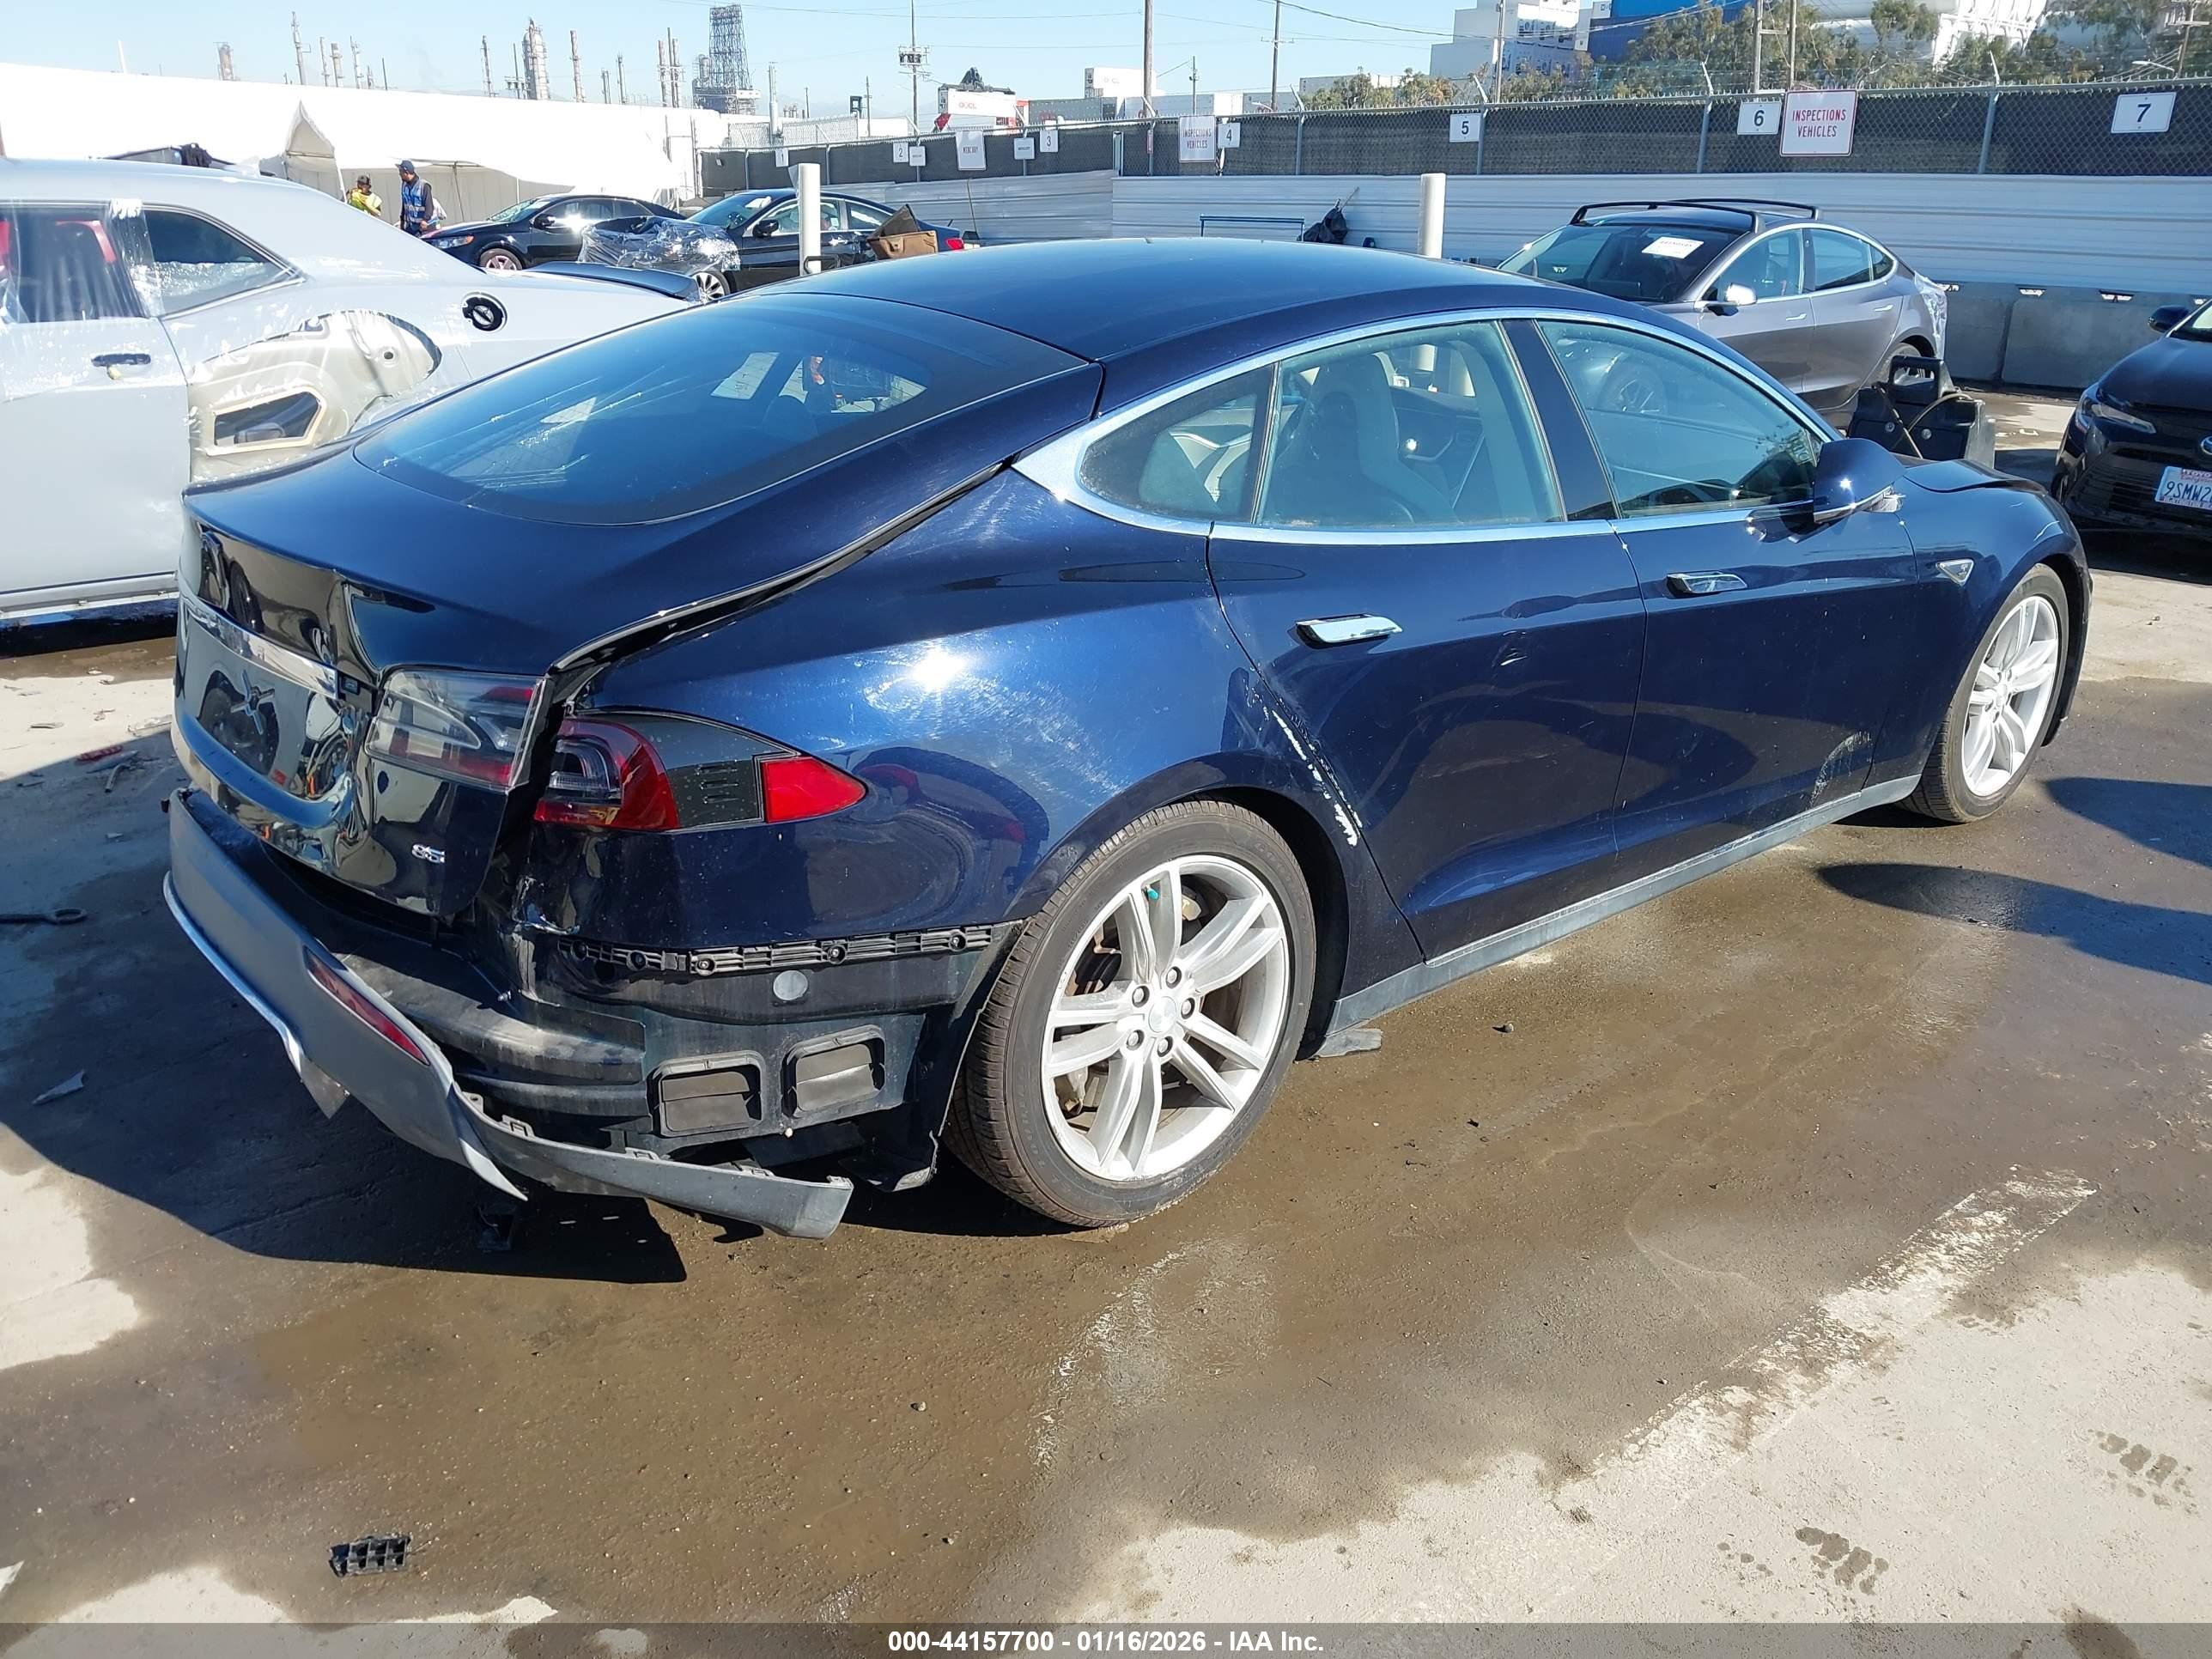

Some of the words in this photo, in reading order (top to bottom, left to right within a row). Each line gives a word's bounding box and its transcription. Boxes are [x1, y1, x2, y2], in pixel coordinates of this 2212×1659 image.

[1754, 110, 1765, 126] 6
[1792, 109, 1846, 122] INSPECTIONS
[2137, 104, 2151, 122] 7
[1462, 121, 1469, 135] 5
[1797, 125, 1838, 137] VEHICLES
[1046, 136, 1052, 147] 3
[1225, 129, 1232, 142] 4
[1186, 139, 1208, 149] VEHICLES
[898, 148, 903, 158] 2
[2164, 481, 2212, 504] 9SMW2
